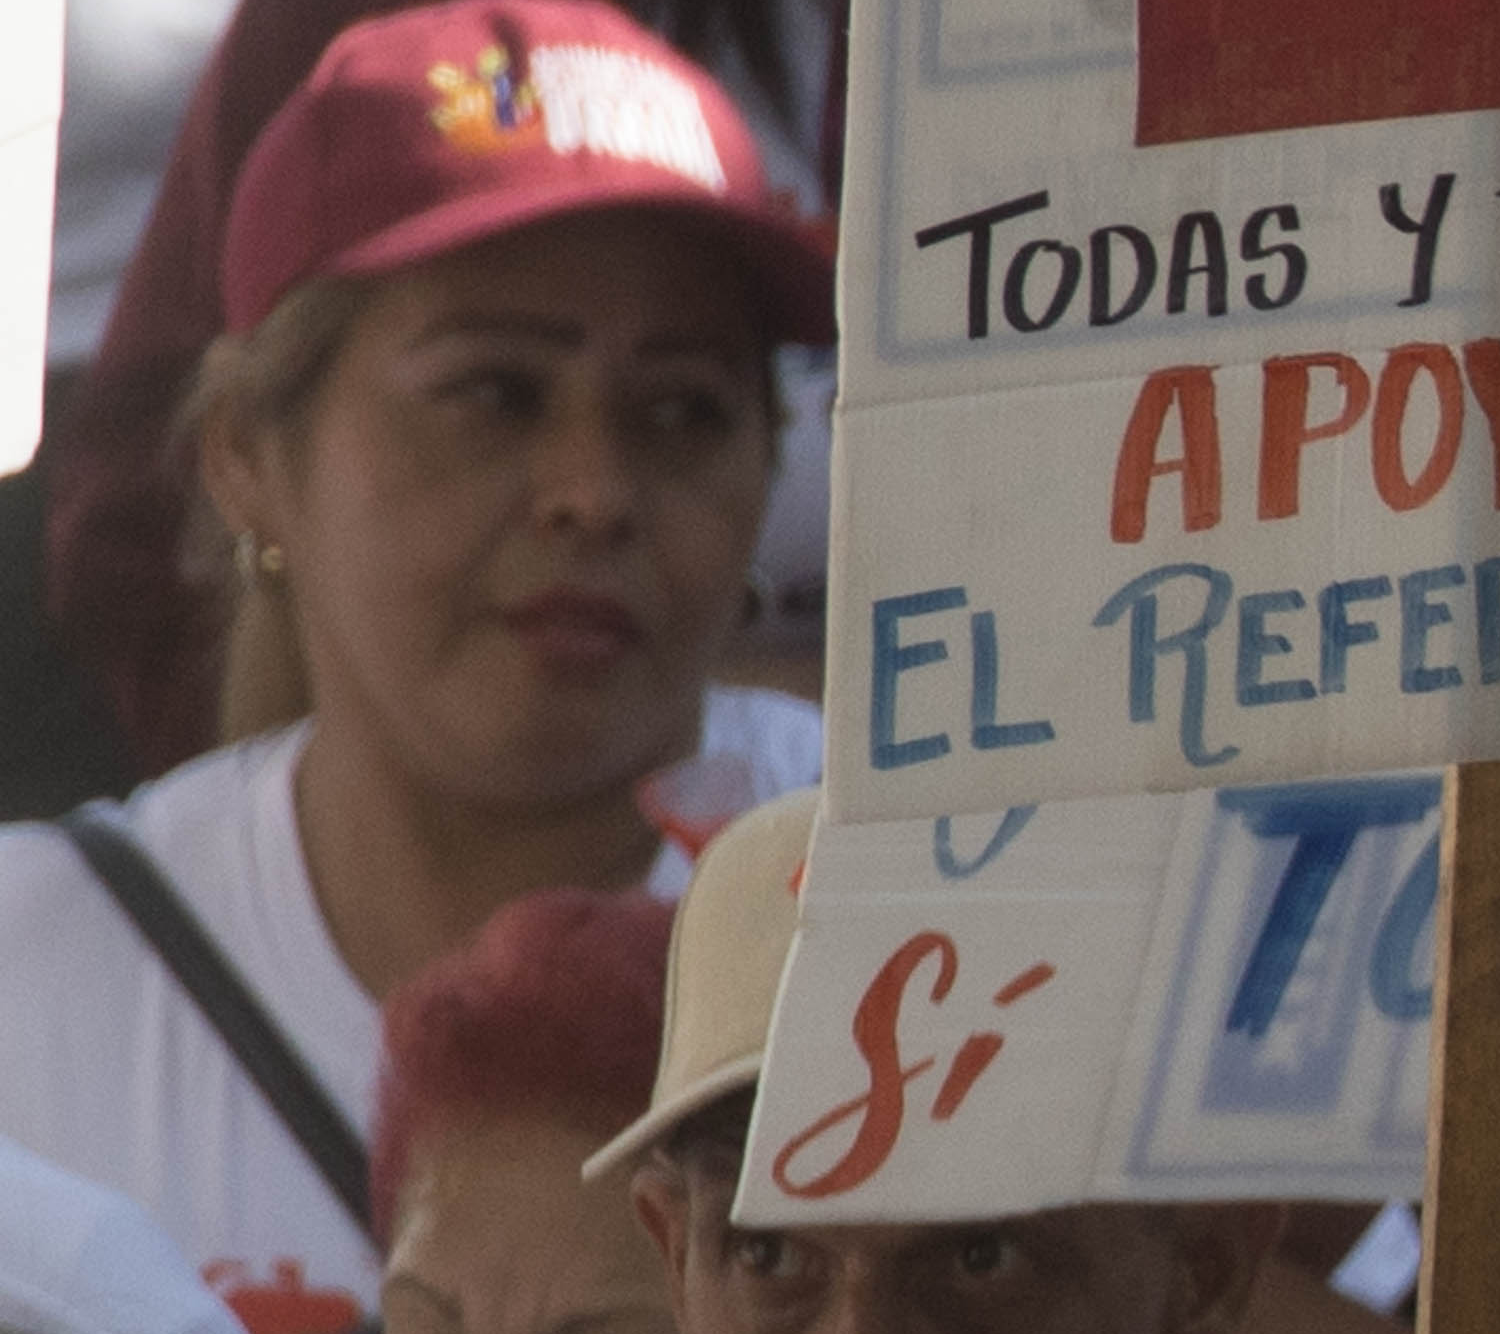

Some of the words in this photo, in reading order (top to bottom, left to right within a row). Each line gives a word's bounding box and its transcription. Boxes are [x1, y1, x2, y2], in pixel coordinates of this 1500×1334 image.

[915, 190, 1308, 340] TODAS
[1379, 172, 1457, 308] Y
[870, 586, 1055, 770] EL
